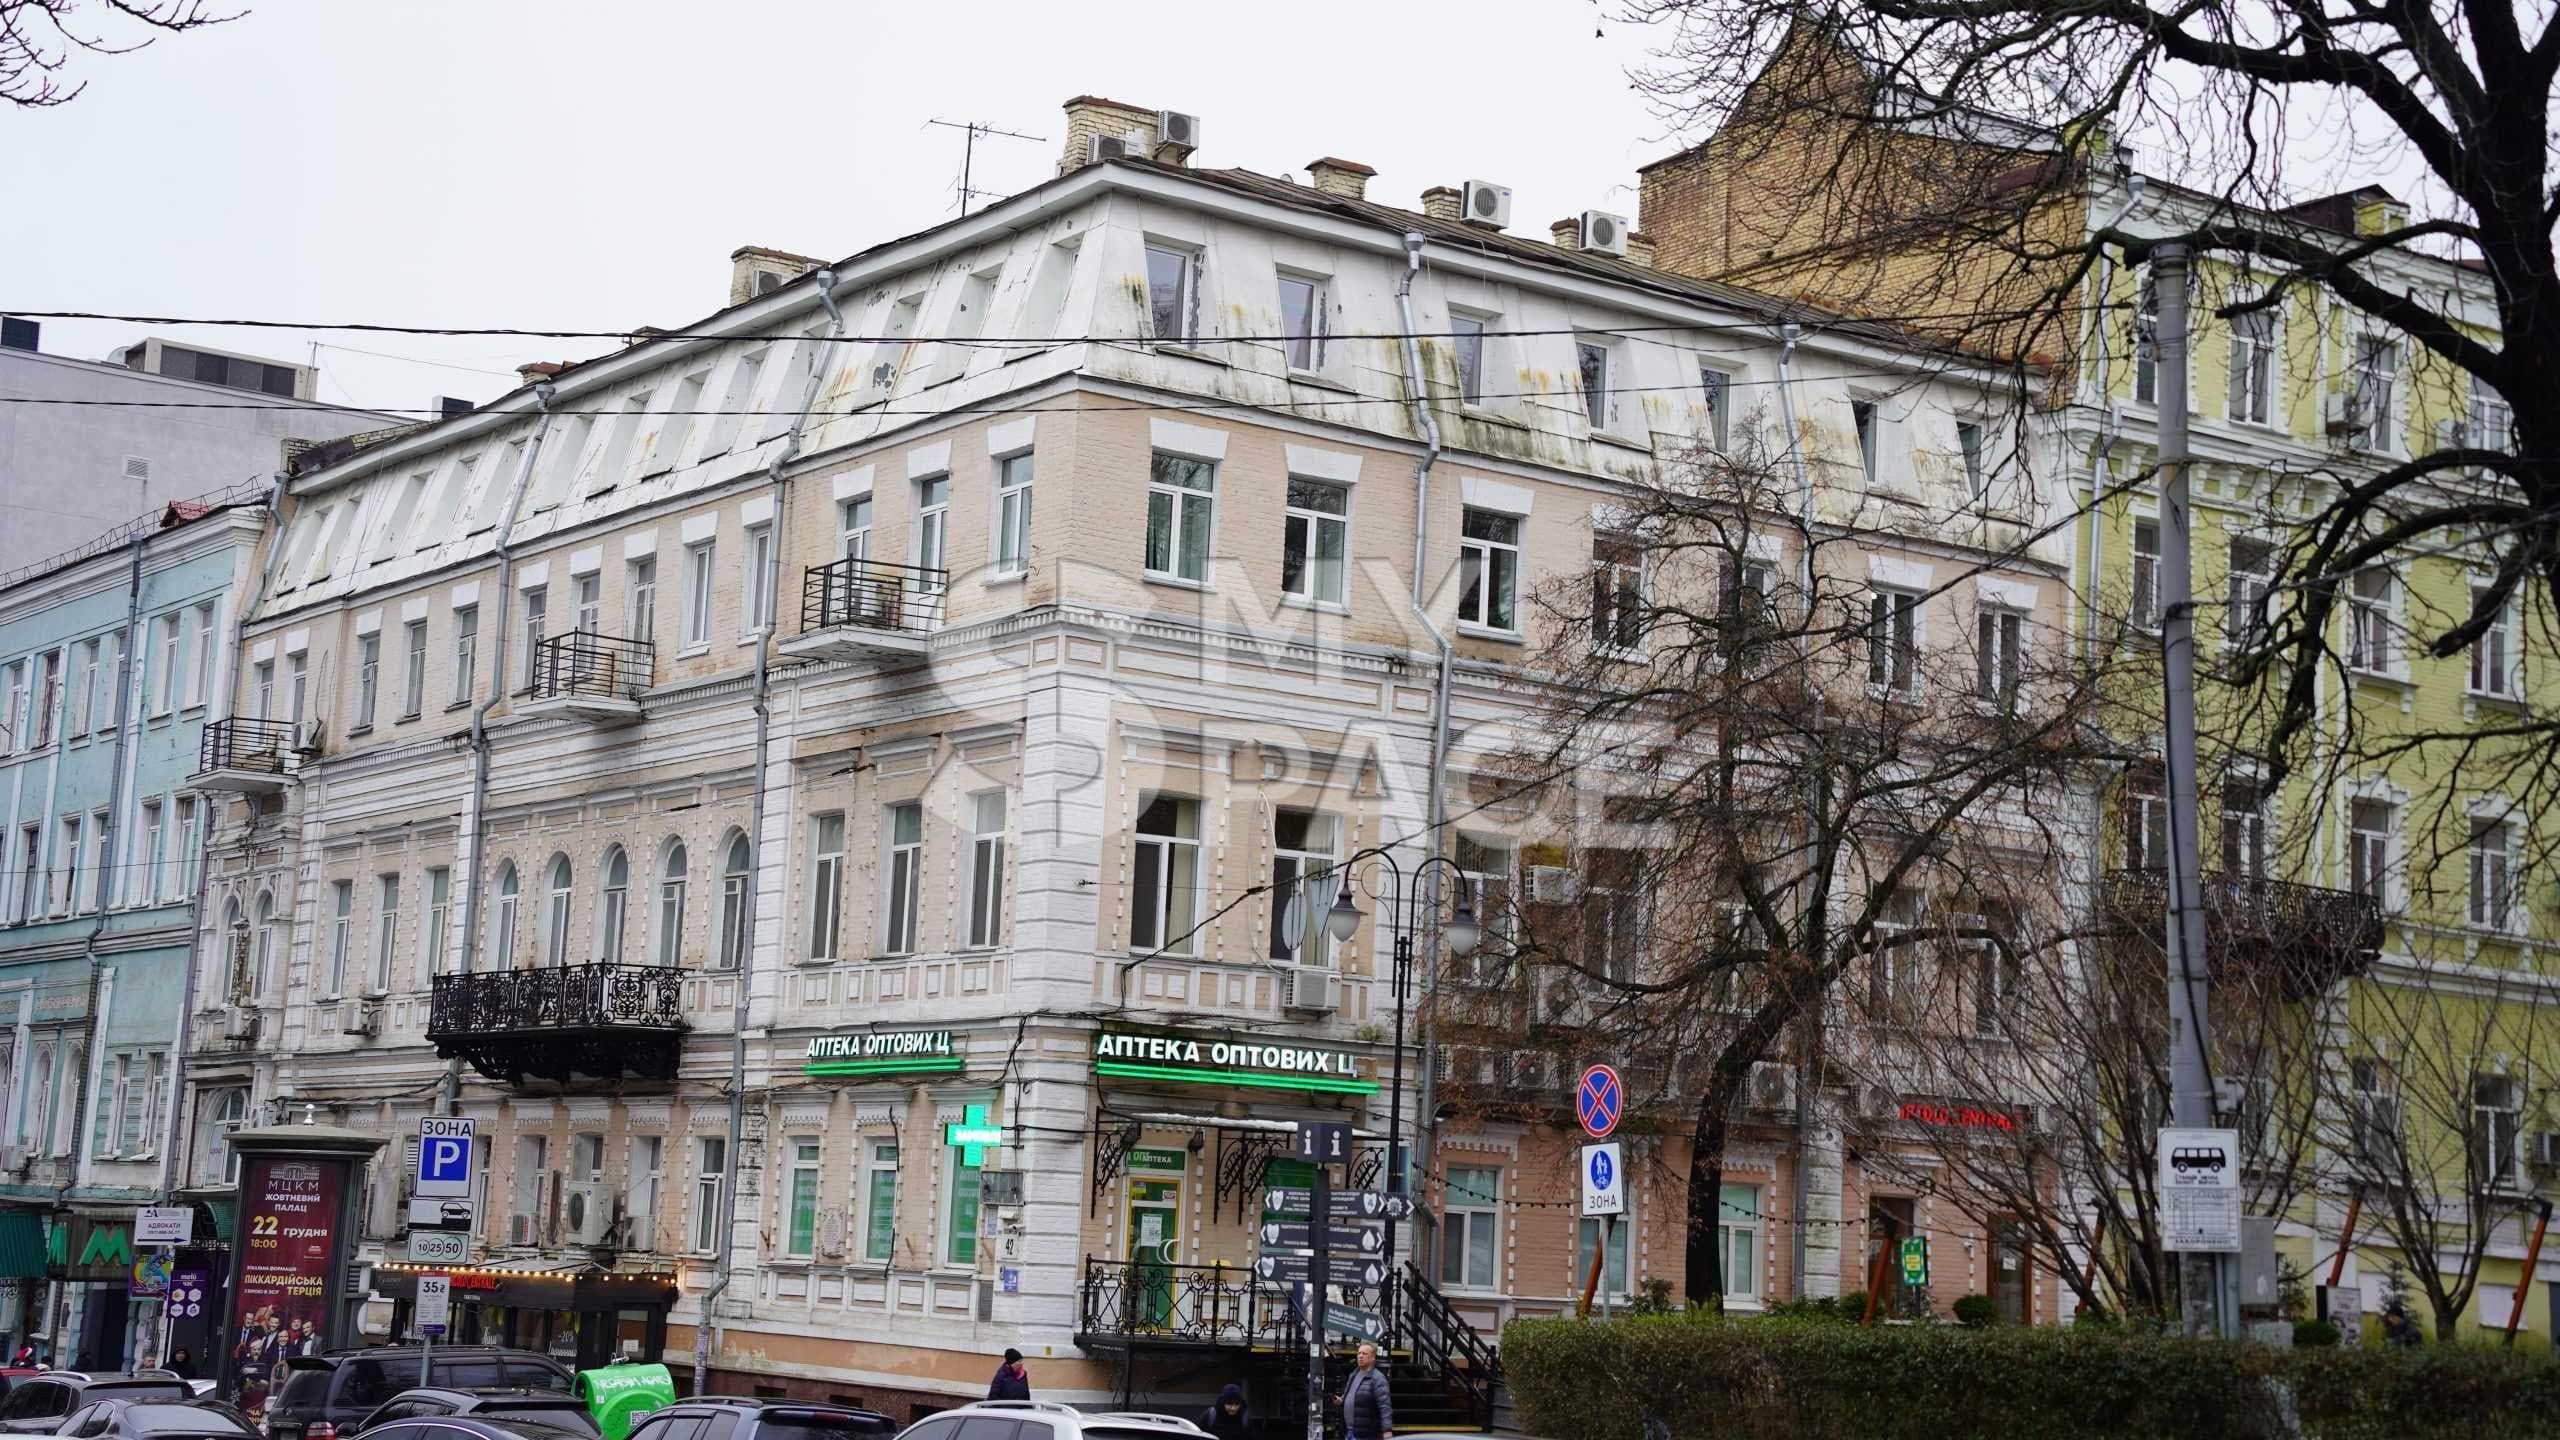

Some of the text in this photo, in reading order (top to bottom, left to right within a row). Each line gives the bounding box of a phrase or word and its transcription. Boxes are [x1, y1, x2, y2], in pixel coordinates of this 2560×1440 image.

[806, 1031, 950, 1057] АПТЕКА ОПТОВИХ Ц
[1097, 1034, 1358, 1078] АПТЕКА ОПТОВИХ Ц
[423, 1121, 472, 1137] ЗОНА
[433, 1141, 460, 1177] P
[264, 1193, 321, 1203] ЖОВТНЕВИЙ
[1589, 1193, 1617, 1208] ЗОНА
[274, 1204, 307, 1213] ПАЛАЦ
[252, 1216, 328, 1238] 22 грудня
[250, 1239, 278, 1249] 18:00
[430, 1243, 442, 1252] 25
[445, 1243, 459, 1253] 50
[1005, 1239, 1014, 1255] 42
[287, 1286, 322, 1297] ТЕРЦІЯ
